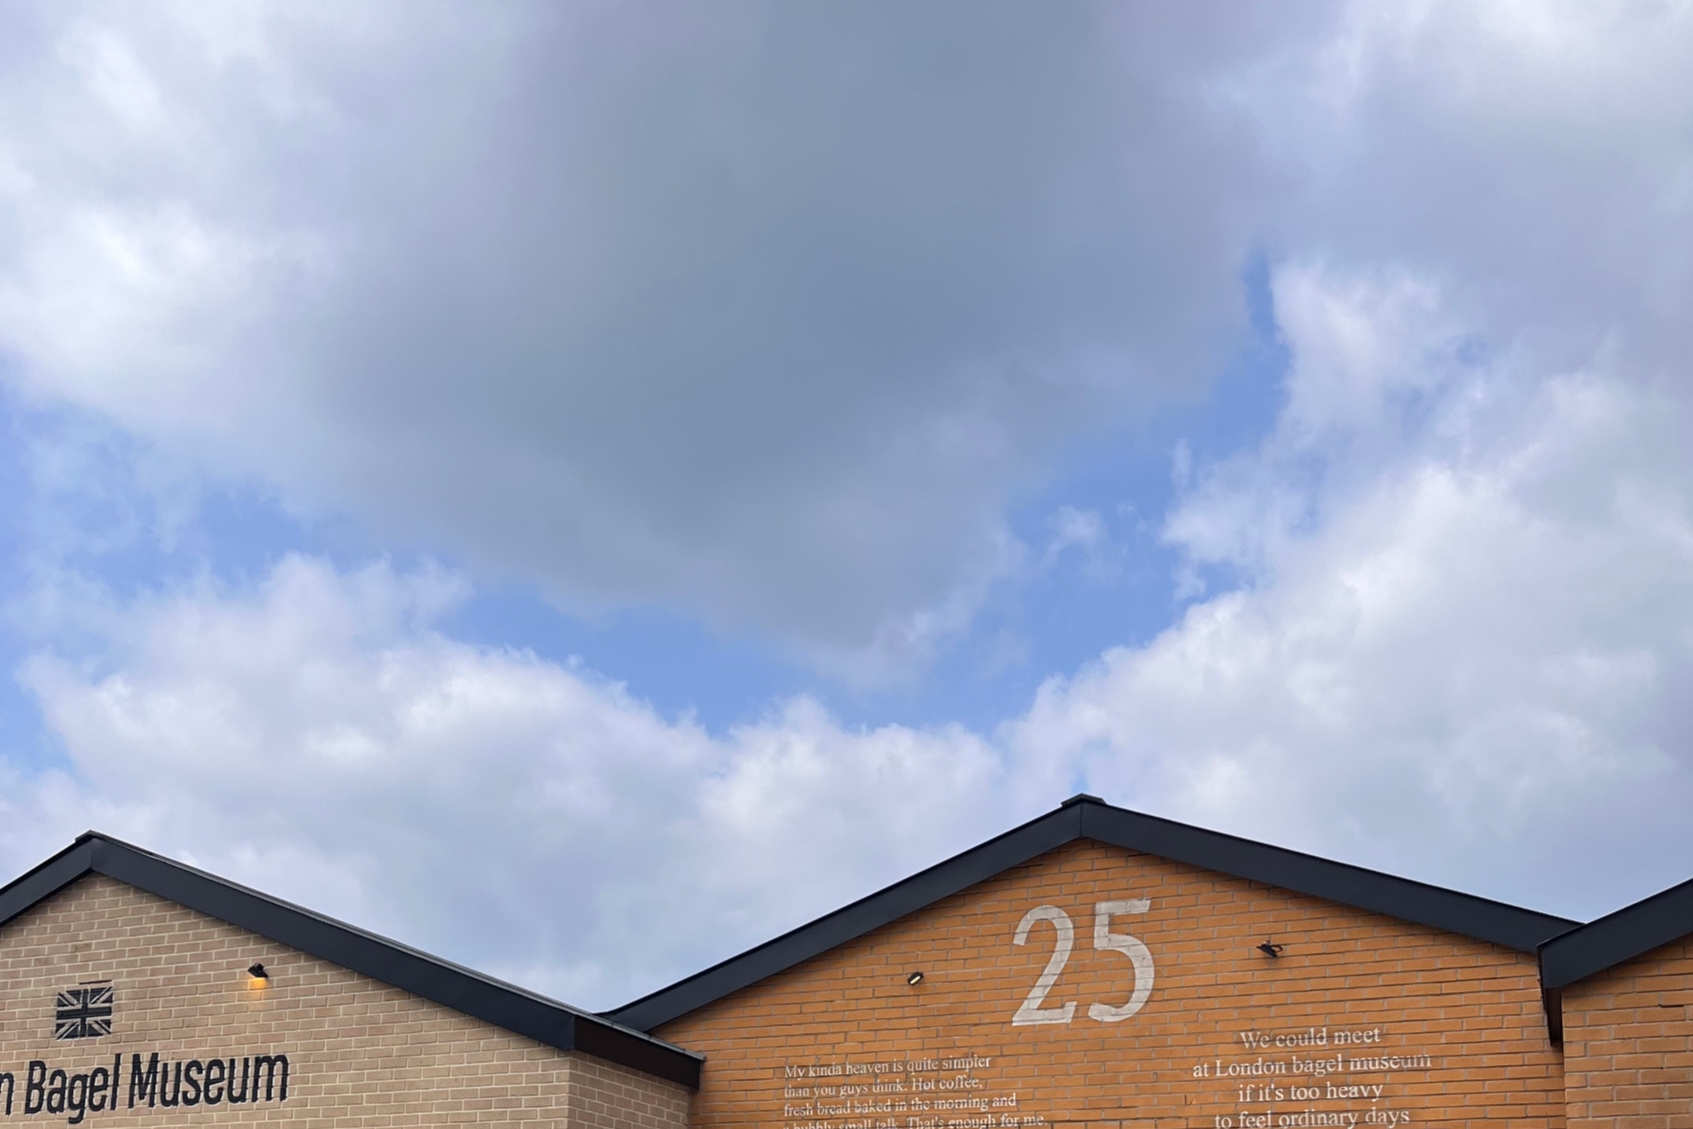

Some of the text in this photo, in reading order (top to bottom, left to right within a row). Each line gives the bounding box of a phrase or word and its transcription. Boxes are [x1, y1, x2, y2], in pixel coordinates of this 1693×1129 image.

[1012, 897, 1155, 1026] 25
[1240, 1026, 1381, 1049] We could meet
[784, 1054, 991, 1081] My kinda heaven is quite simpler
[1192, 1053, 1433, 1078] at London bagel museum
[24, 1052, 122, 1125] Bagel
[128, 1052, 289, 1110] Museum
[784, 1084, 809, 1098] than
[813, 1086, 836, 1100] you
[839, 1085, 868, 1099] guys
[911, 1077, 935, 1091] Hot
[939, 1075, 983, 1090] coffee,
[1238, 1081, 1384, 1102] if it's too heavy
[784, 1092, 1017, 1117] fresh bread baked in the morning and
[1000, 1113, 1020, 1127] for
[1023, 1115, 1049, 1127] me.
[1214, 1107, 1411, 1129] to feel ordinary days
